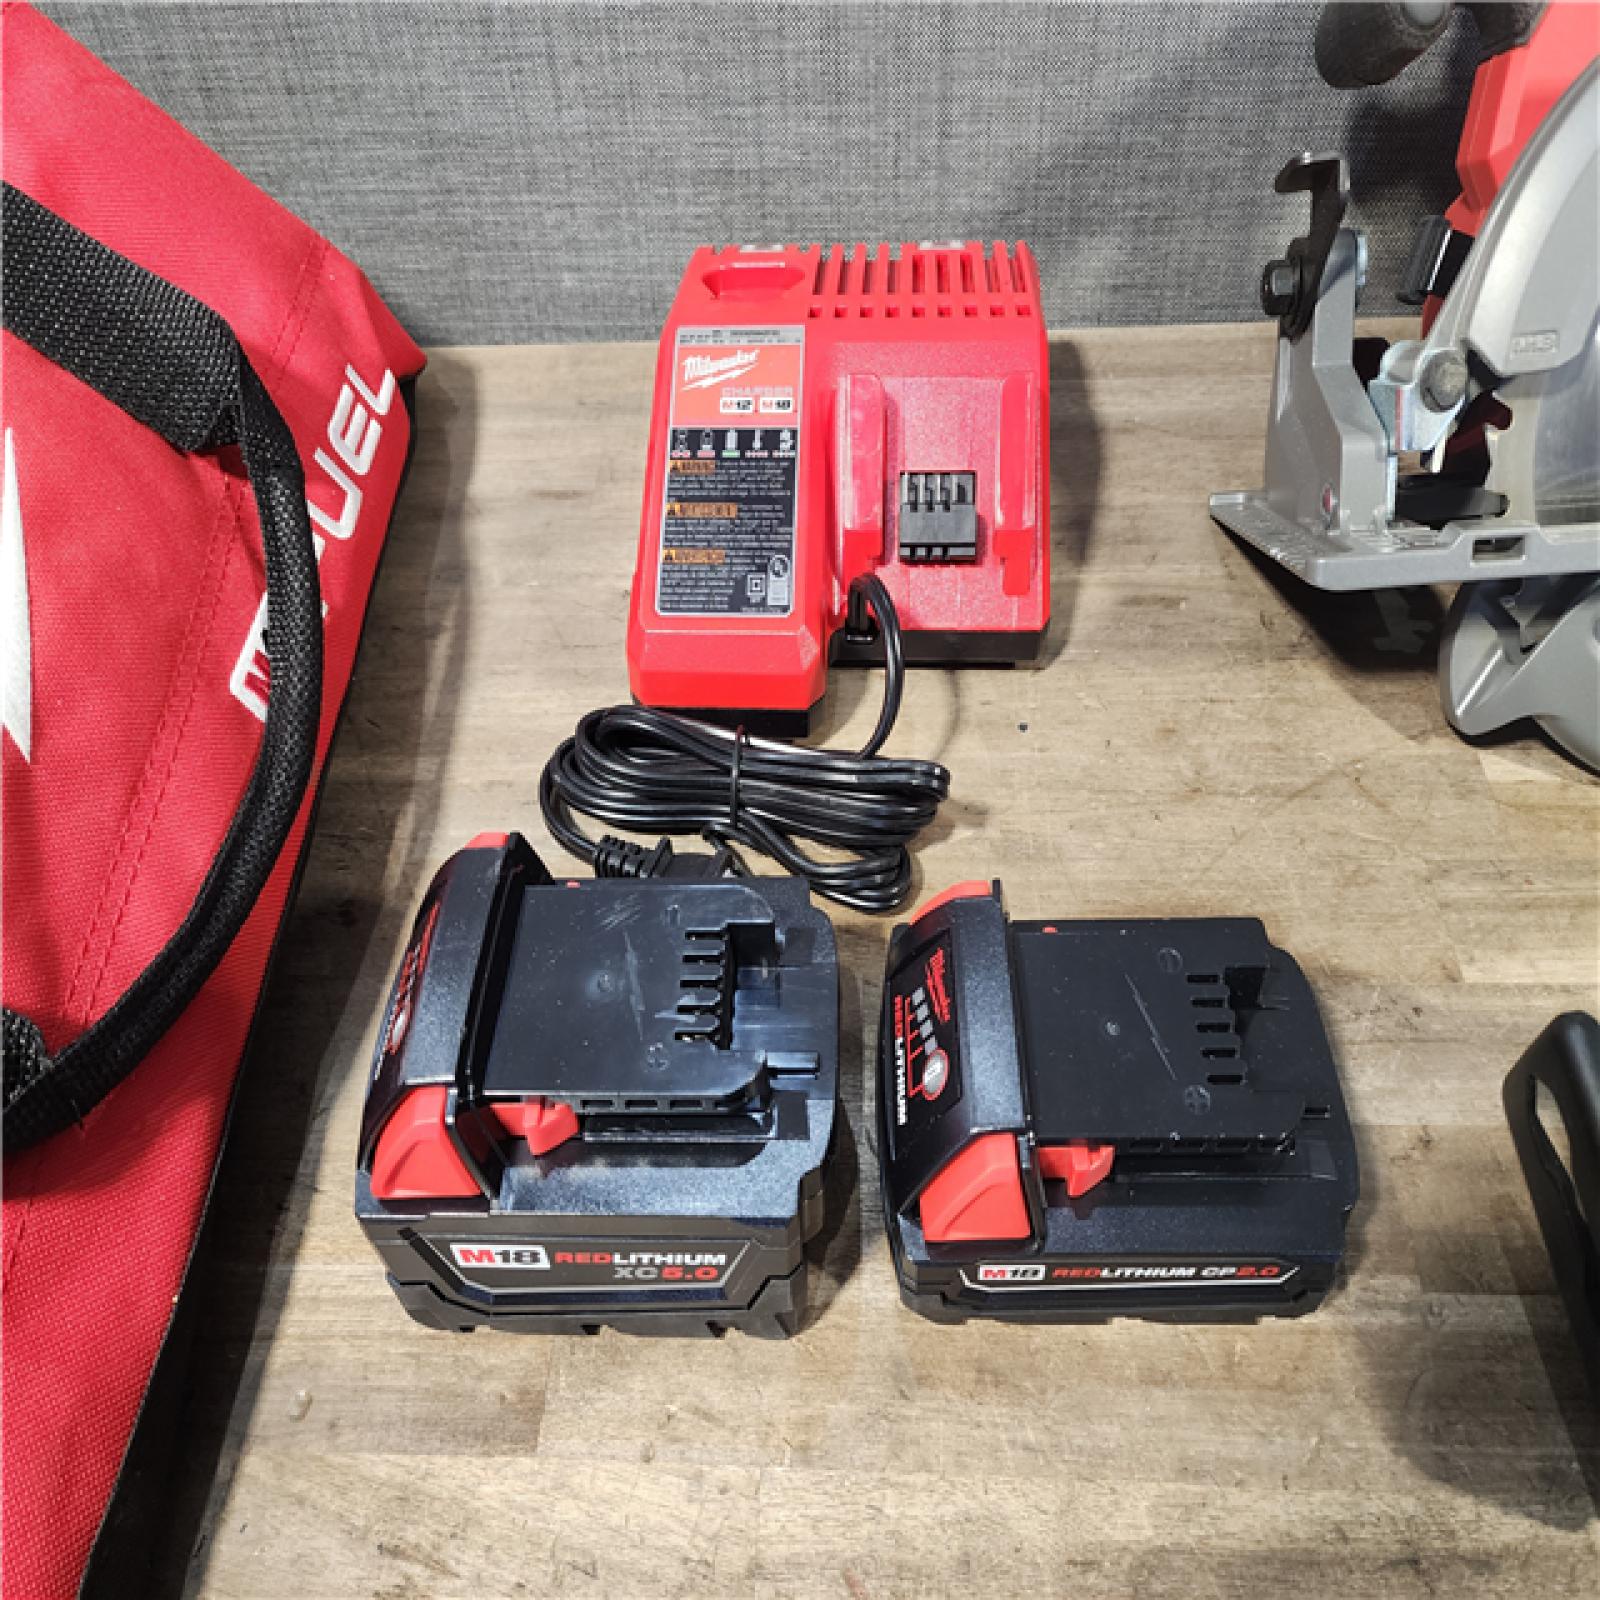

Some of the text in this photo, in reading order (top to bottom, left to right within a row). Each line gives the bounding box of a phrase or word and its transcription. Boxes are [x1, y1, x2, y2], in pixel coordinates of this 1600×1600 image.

[307, 362, 397, 560] UEL
[458, 1249, 727, 1266] M18 REDLITHIUM
[983, 1268, 1042, 1279] M18
[1052, 1267, 1197, 1278] REDLITHIUM
